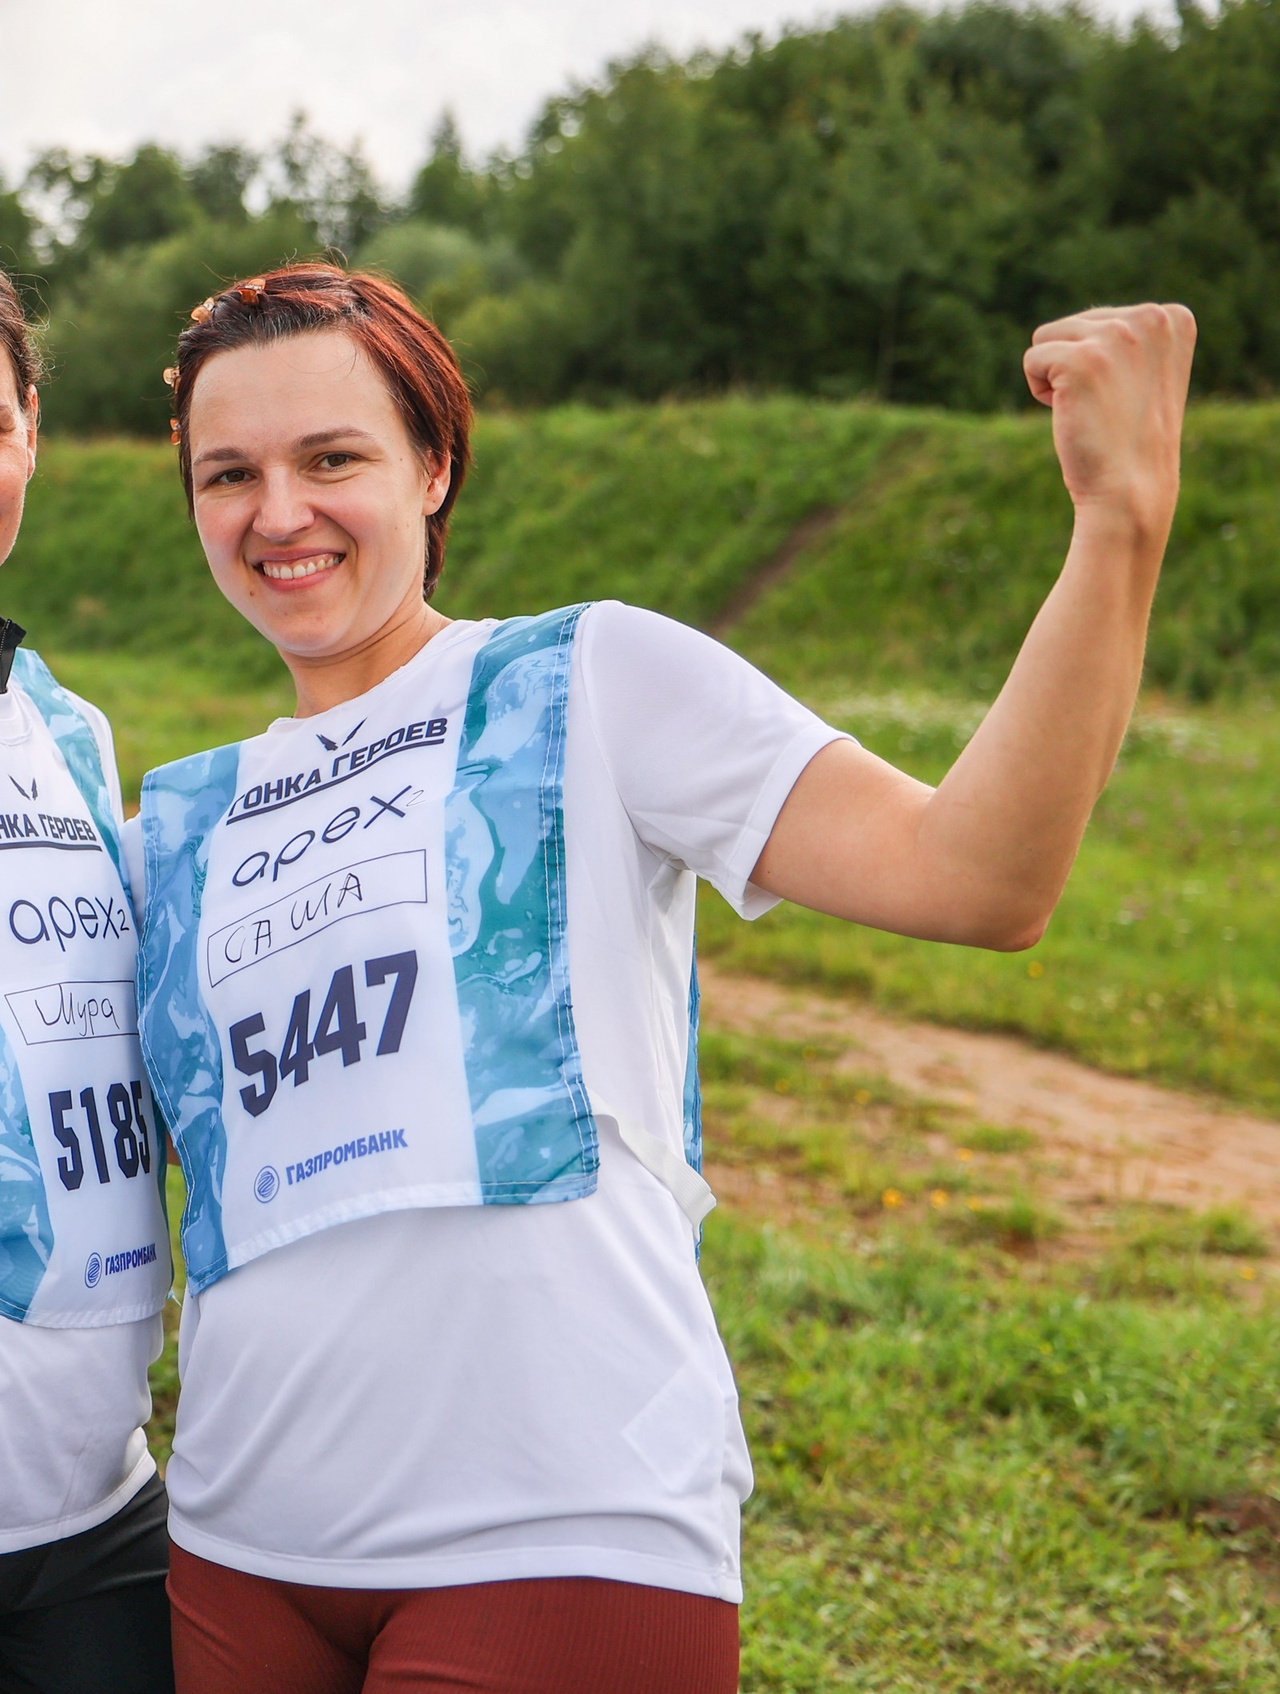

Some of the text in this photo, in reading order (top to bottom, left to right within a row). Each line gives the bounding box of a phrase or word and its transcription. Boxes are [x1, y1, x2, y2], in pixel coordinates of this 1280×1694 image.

[227, 717, 448, 818] ГОНКА ГЕРОЕВ
[37, 813, 98, 842] ГЕРОЕВ
[228, 949, 419, 1118] 5447
[48, 1080, 152, 1191] 5185
[285, 1128, 408, 1186] ГАЗПРОМБАНК
[104, 1242, 158, 1276] ГАЗПРОМБАНК
